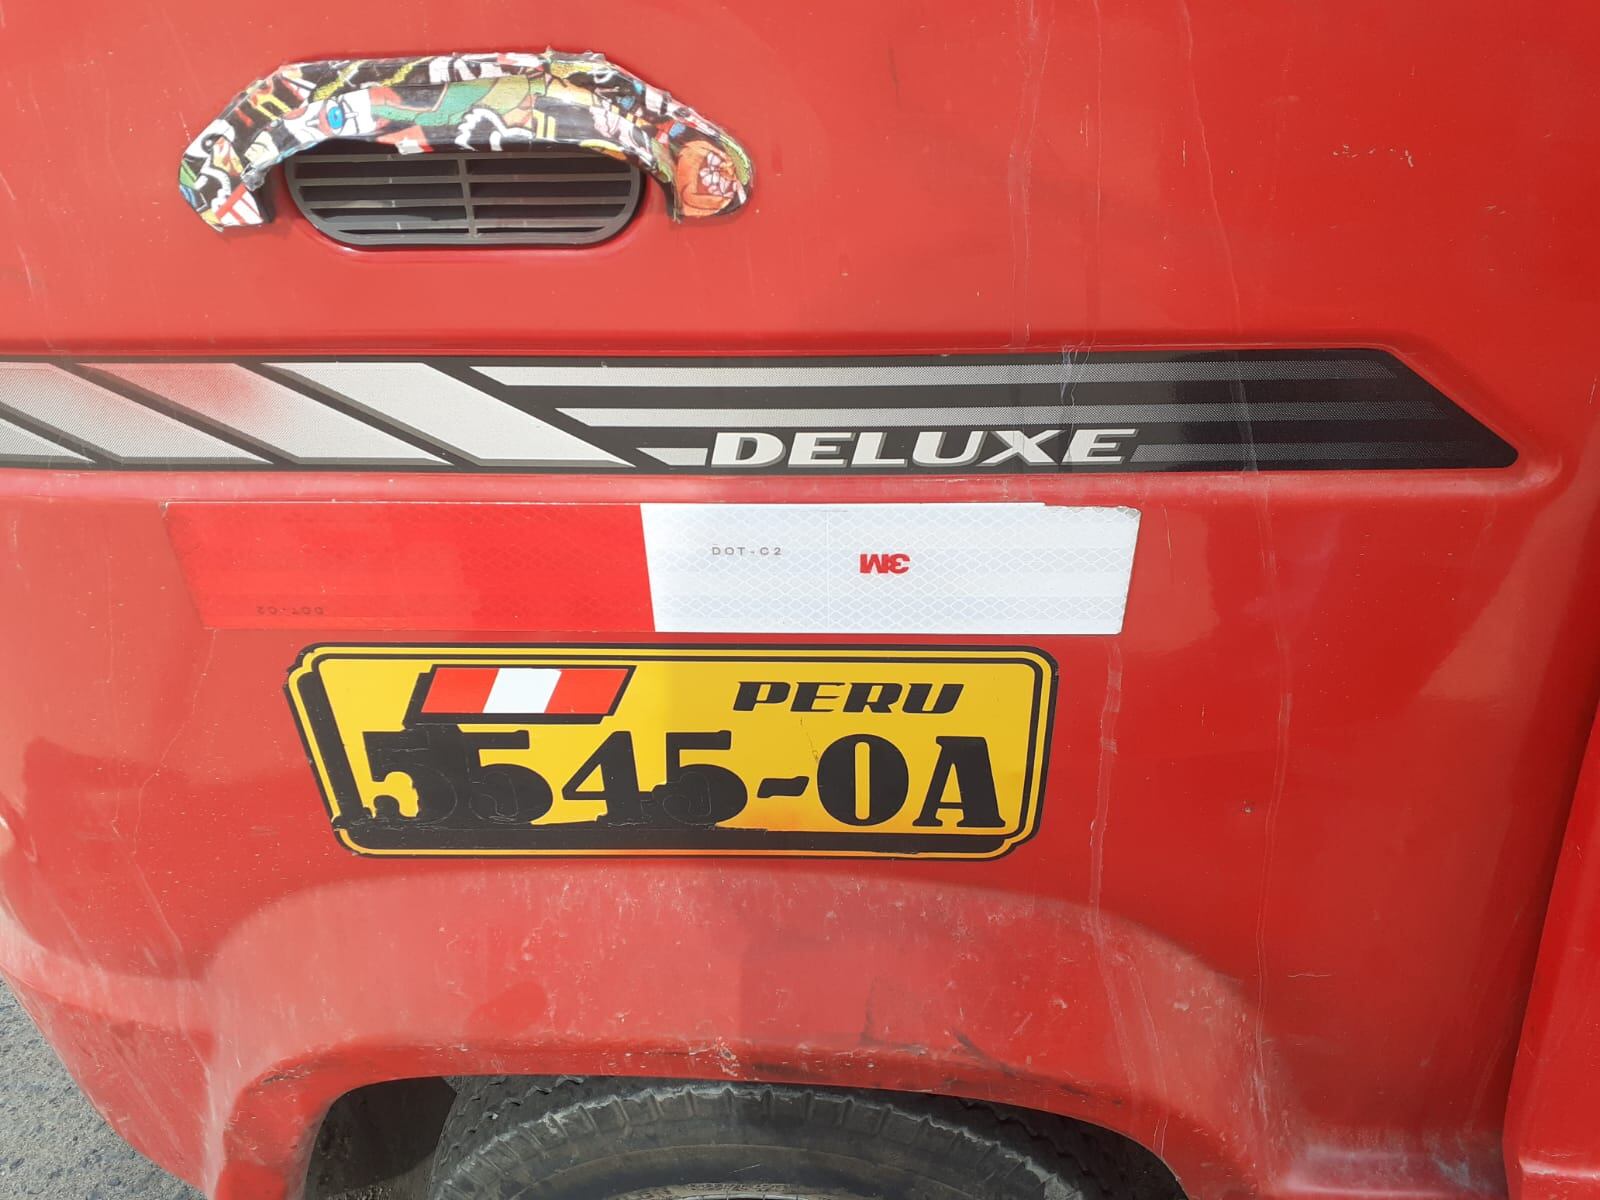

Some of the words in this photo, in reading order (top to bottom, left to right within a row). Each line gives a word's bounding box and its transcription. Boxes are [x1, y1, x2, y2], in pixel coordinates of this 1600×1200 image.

[711, 429, 1137, 469] DELUXE
[711, 545, 782, 556] DOT-C2
[860, 553, 910, 574] 3M
[735, 681, 962, 713] PERU
